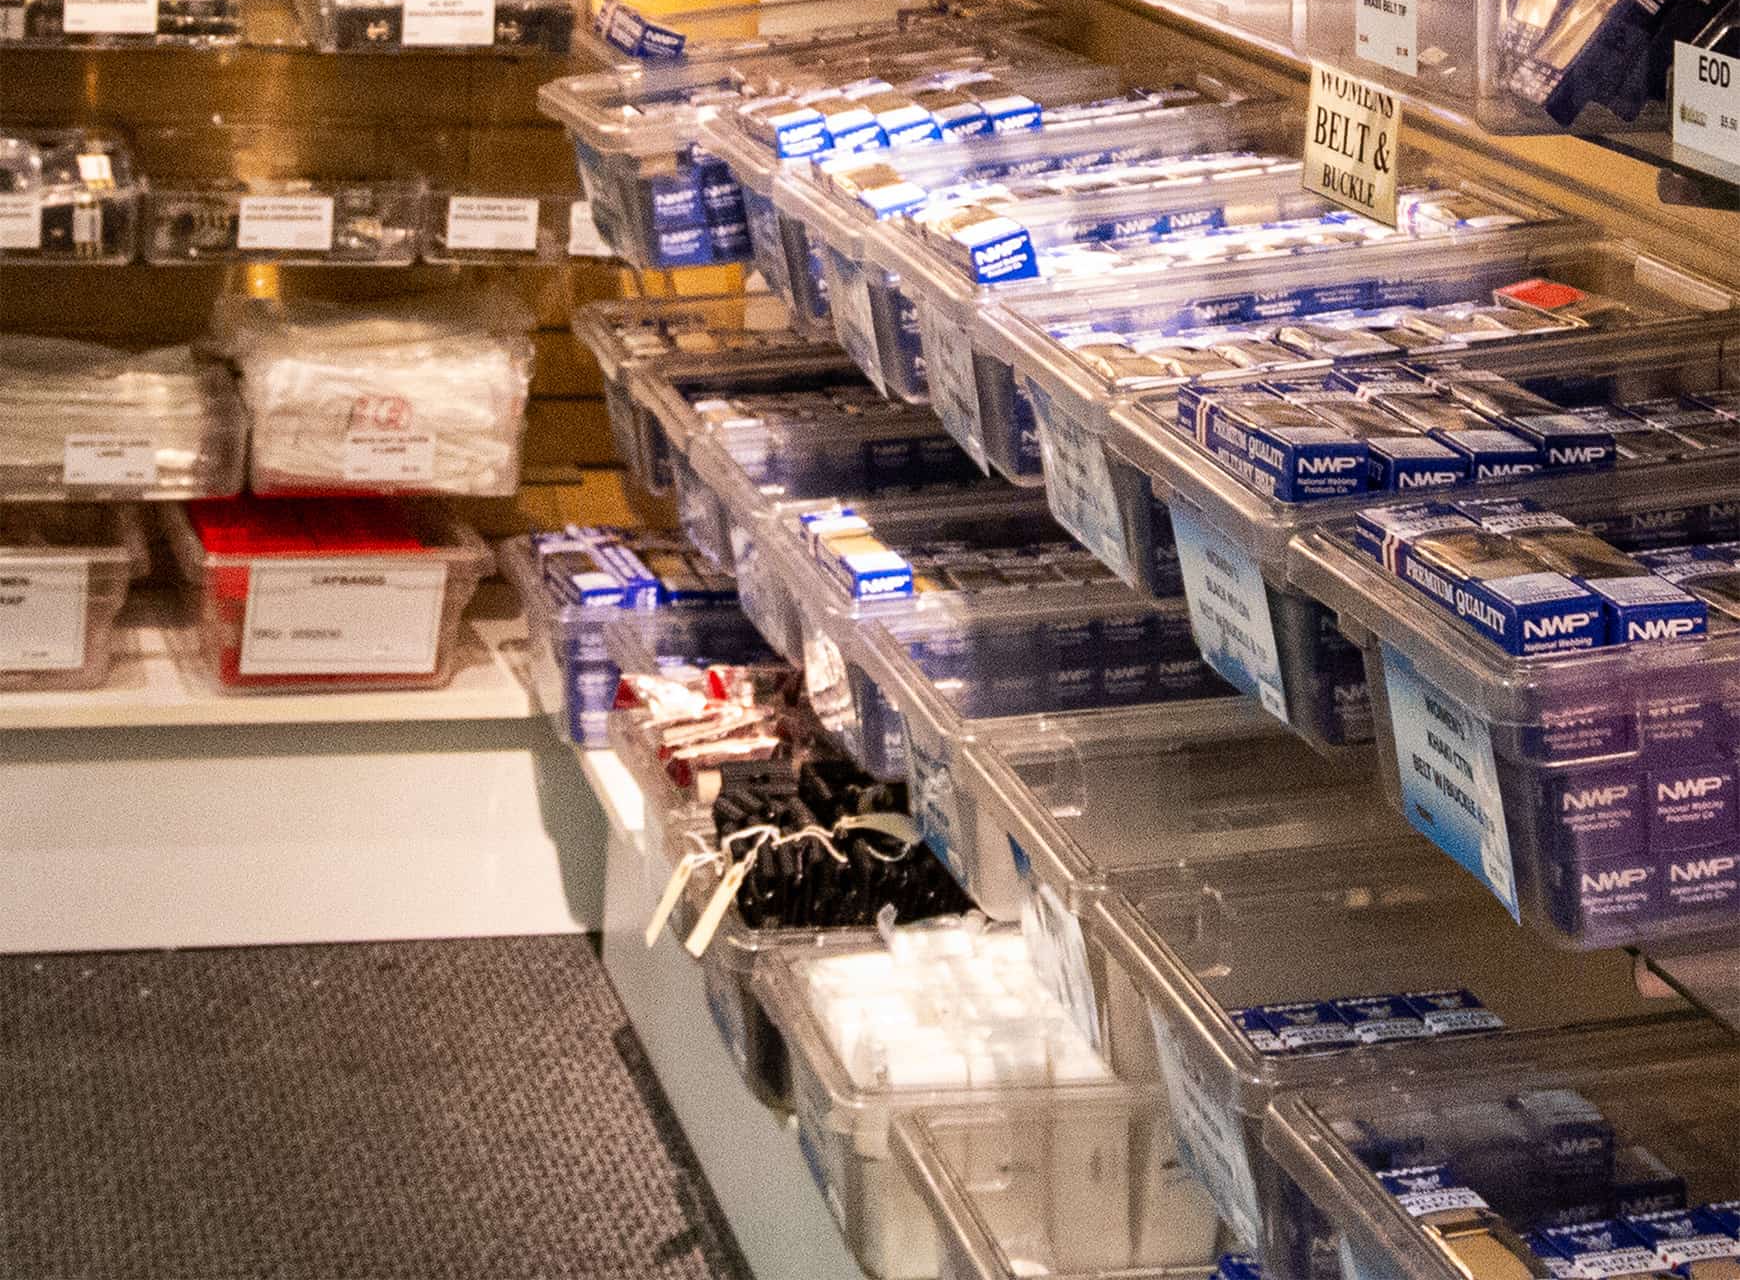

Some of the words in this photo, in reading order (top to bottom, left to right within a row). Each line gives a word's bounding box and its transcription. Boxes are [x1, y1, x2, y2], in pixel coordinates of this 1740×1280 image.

[1382, 0, 1397, 15] BELT
[1698, 54, 1731, 89] EOD
[1321, 70, 1394, 119] WOMENS
[1313, 105, 1371, 163] BELT
[1373, 130, 1390, 175] &
[1322, 163, 1377, 209] BUCKLE
[1212, 415, 1249, 452] PREMIUM
[1249, 435, 1285, 470] QUALITY
[1217, 447, 1253, 485] MILITARY
[1297, 477, 1326, 487] National
[1326, 477, 1358, 487] Webbing
[1304, 486, 1336, 495] Products
[1406, 552, 1454, 606] PREMIUM
[1456, 588, 1506, 635] QUALITY
[1523, 640, 1558, 653] National
[1558, 637, 1593, 650] Webbing
[1412, 751, 1432, 782] BELT
